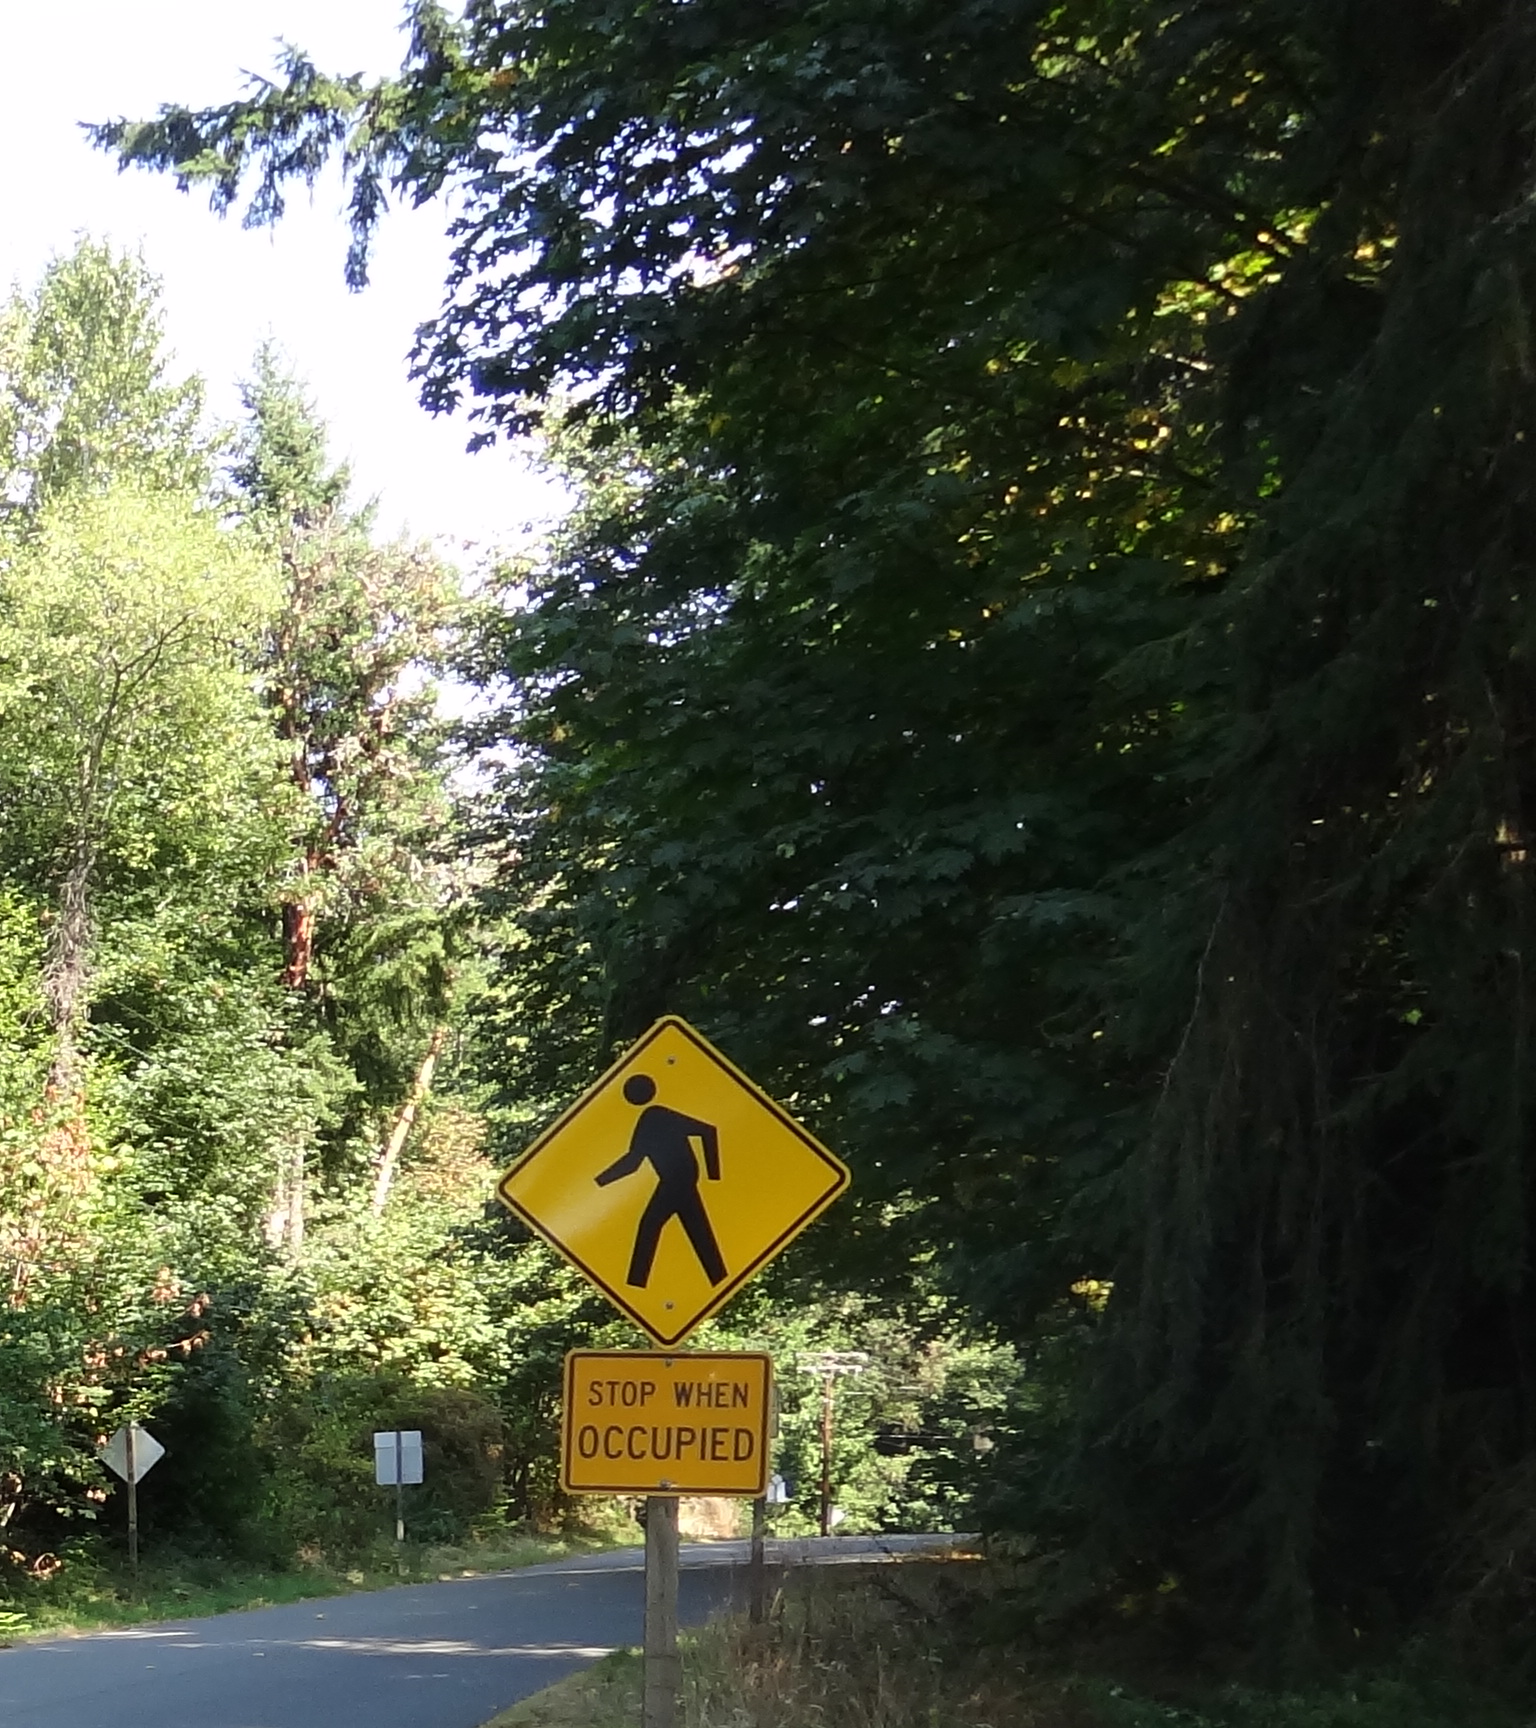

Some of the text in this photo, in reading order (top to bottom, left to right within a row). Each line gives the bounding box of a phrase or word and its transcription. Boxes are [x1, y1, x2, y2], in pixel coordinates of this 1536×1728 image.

[589, 1381, 749, 1408] STOP WHEN
[579, 1425, 754, 1461] OCCUPIED
